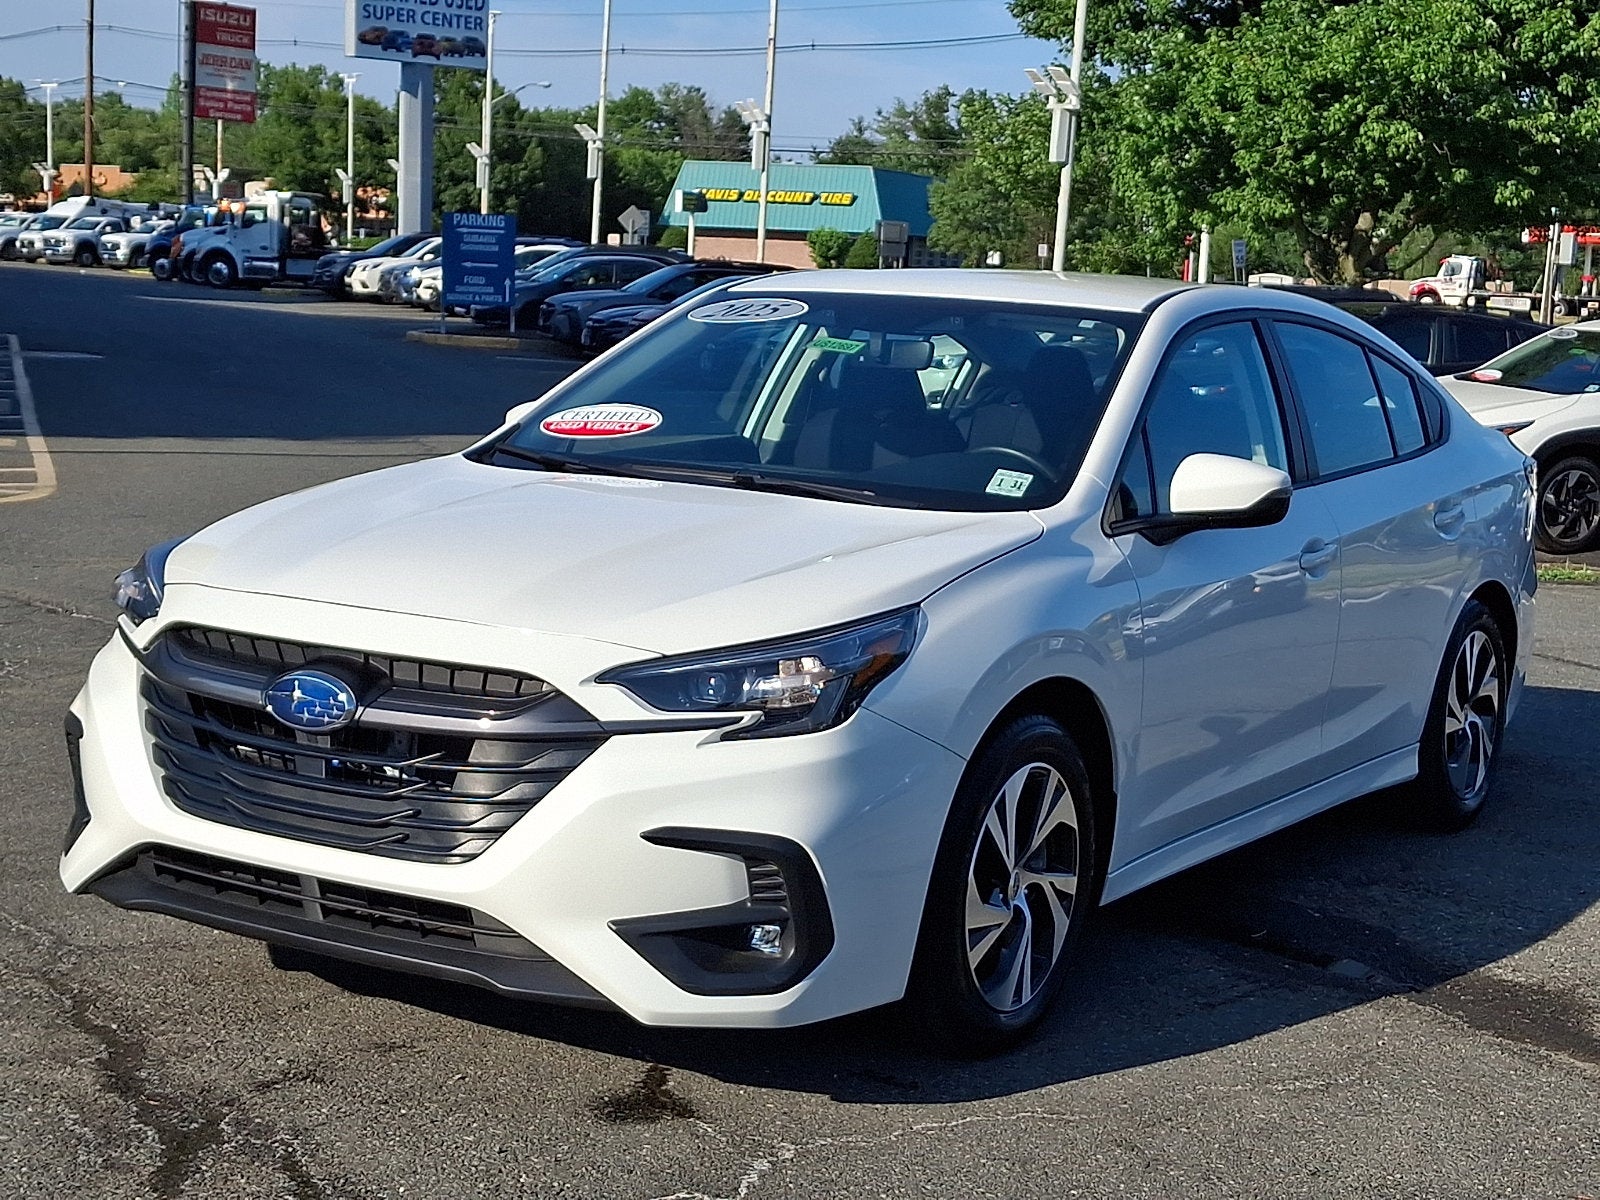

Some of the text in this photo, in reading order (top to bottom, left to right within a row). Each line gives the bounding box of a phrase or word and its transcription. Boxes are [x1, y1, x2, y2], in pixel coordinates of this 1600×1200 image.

[200, 8, 250, 26] ISUZU
[362, 4, 483, 31] SUPER CENTER
[702, 188, 853, 205] AVIS DICOUNT TIRE
[453, 213, 505, 227] PARKING
[464, 275, 485, 284] FORD
[701, 303, 793, 318] 2025
[560, 410, 653, 421] CERTIFIED
[549, 420, 639, 431] USED VEHICLE
